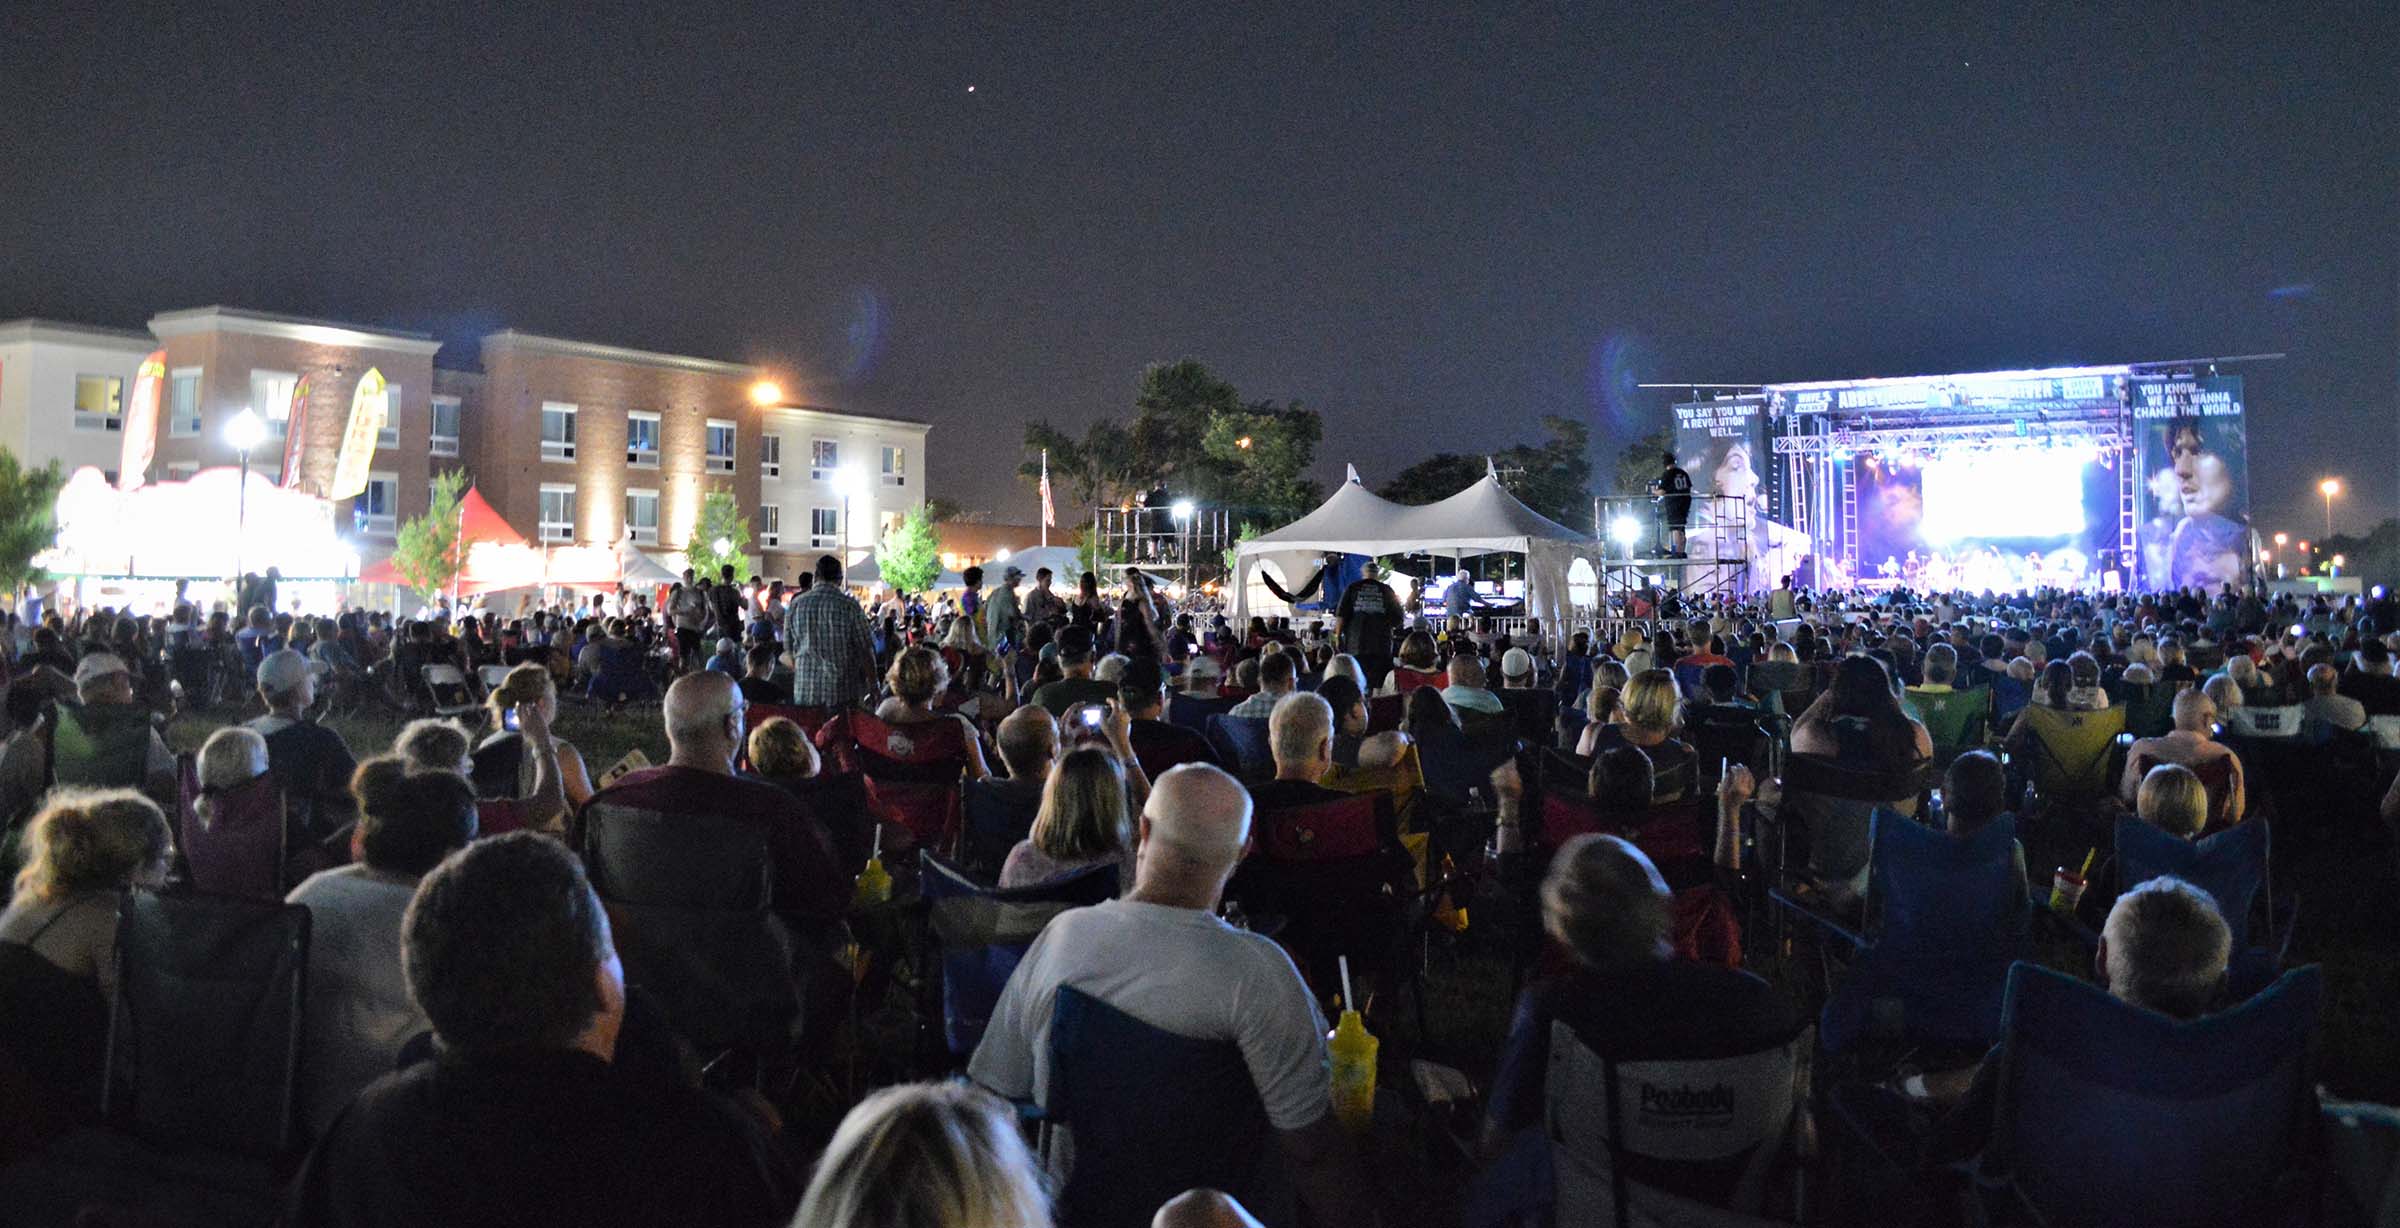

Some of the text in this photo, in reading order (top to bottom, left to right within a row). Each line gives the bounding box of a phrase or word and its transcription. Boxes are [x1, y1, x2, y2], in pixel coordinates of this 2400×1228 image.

[2140, 383, 2206, 396] YOU KNOW...
[1838, 391, 1883, 409] ABBEY
[2147, 392, 2230, 407] WE ALL WANNA
[1676, 405, 1760, 419] YOU SAY YOU WANT
[2134, 403, 2240, 418] CHANGE THE WORLD
[1682, 416, 1745, 429] A REVOLUTION
[1674, 475, 1687, 490] 01
[1640, 1083, 1734, 1113] Peabody
